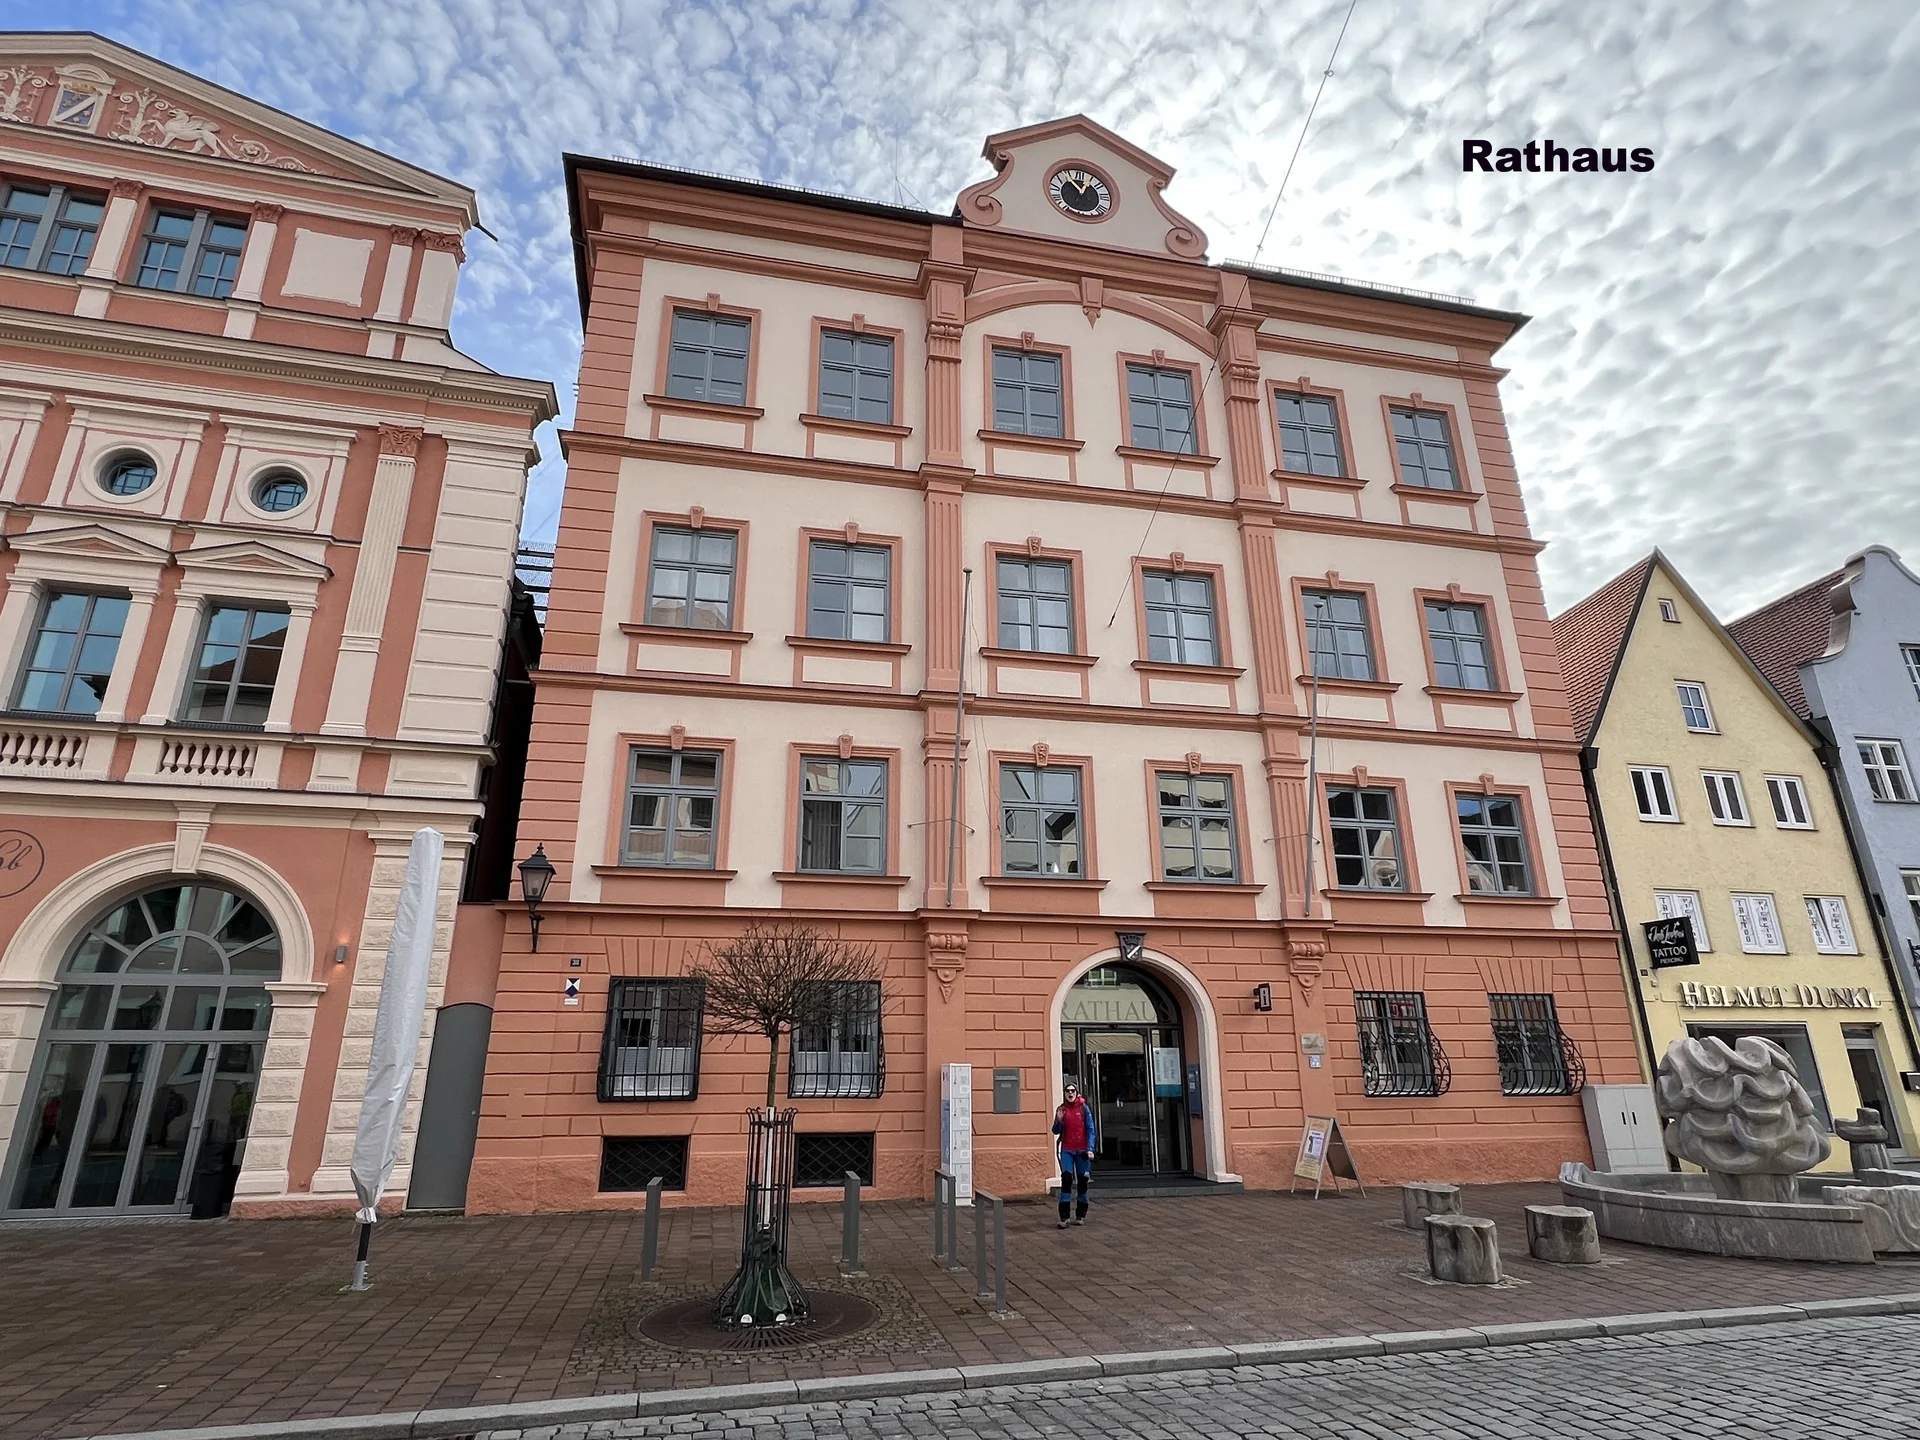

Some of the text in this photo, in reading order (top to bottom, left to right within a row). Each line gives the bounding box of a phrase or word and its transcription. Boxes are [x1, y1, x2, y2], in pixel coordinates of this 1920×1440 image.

[1652, 945, 1688, 958] TATTOO
[1679, 981, 1882, 1009] HELMUT DUNKL
